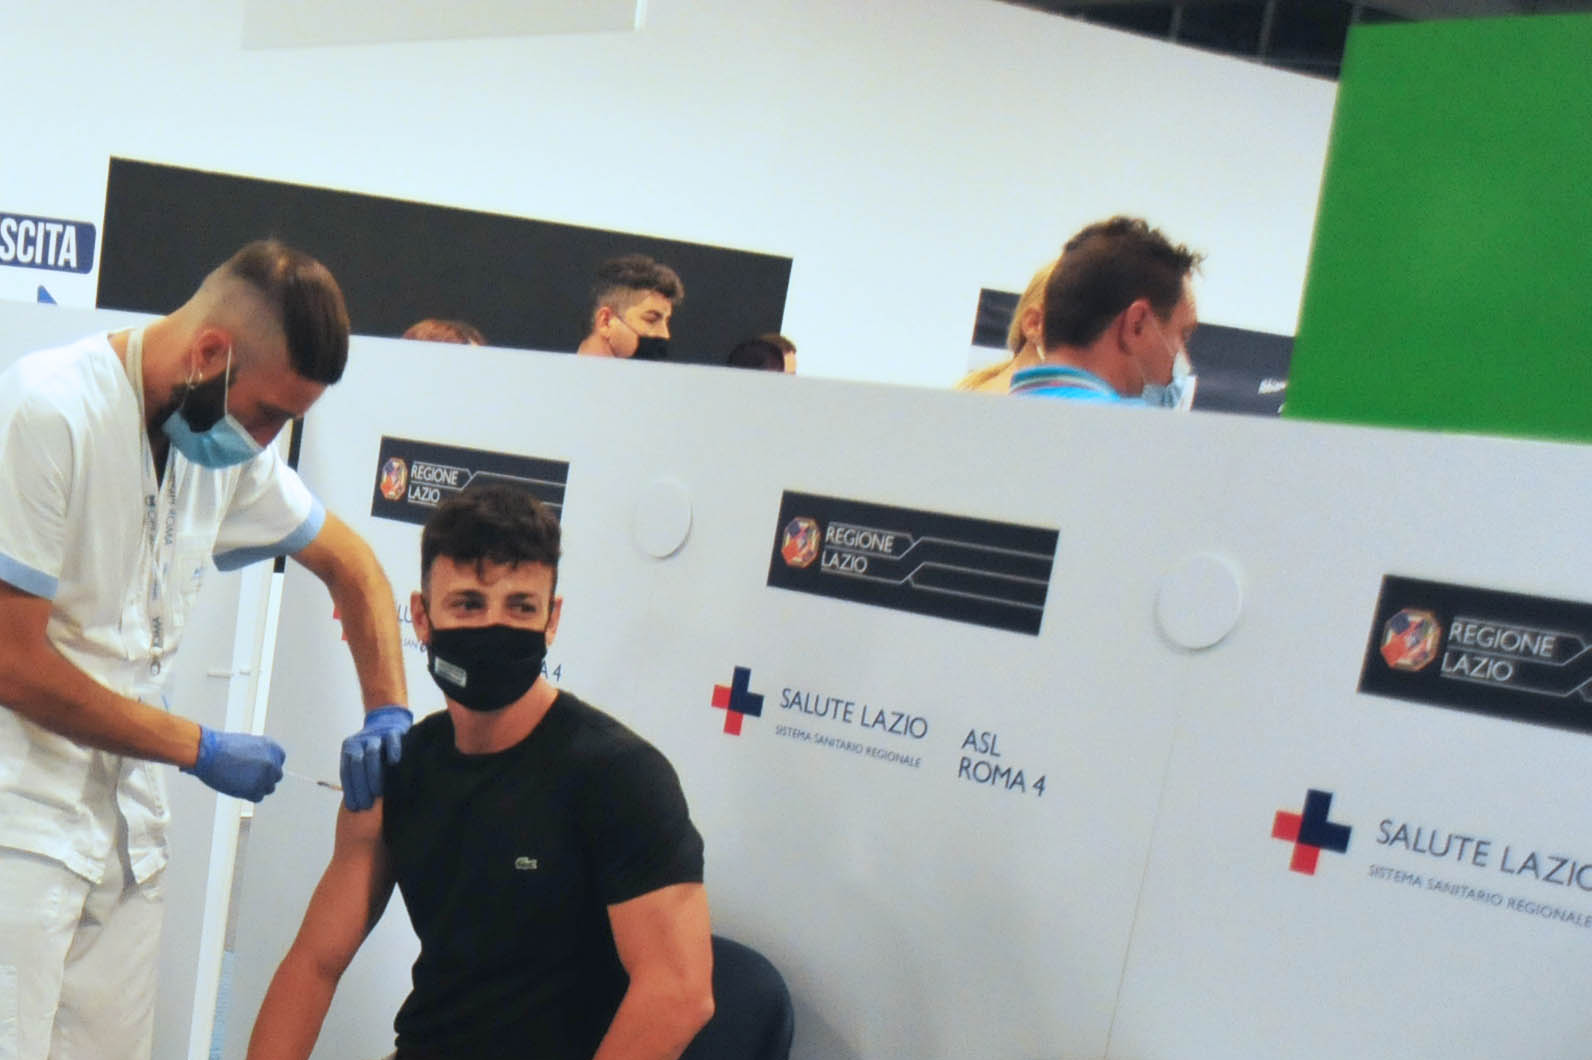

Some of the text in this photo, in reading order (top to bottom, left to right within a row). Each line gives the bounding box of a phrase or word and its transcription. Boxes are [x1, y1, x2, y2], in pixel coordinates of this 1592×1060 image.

[411, 464, 458, 485] REGIONE
[408, 484, 440, 503] LAZIO
[825, 526, 896, 553] REGIONE
[821, 550, 868, 573] LAZIO
[1448, 621, 1556, 657] REGIONE
[1441, 652, 1513, 681] LAZIO
[780, 687, 928, 740] SALUTE LAZIO
[776, 724, 921, 769] SISTEMA SANITARIO REGIONALE
[961, 729, 1001, 758] ASL
[958, 756, 1047, 798] ROMA 4
[1376, 818, 1491, 867] SALUTE
[1367, 864, 1592, 928] SISTEMA SANITARIO REGIONALE
